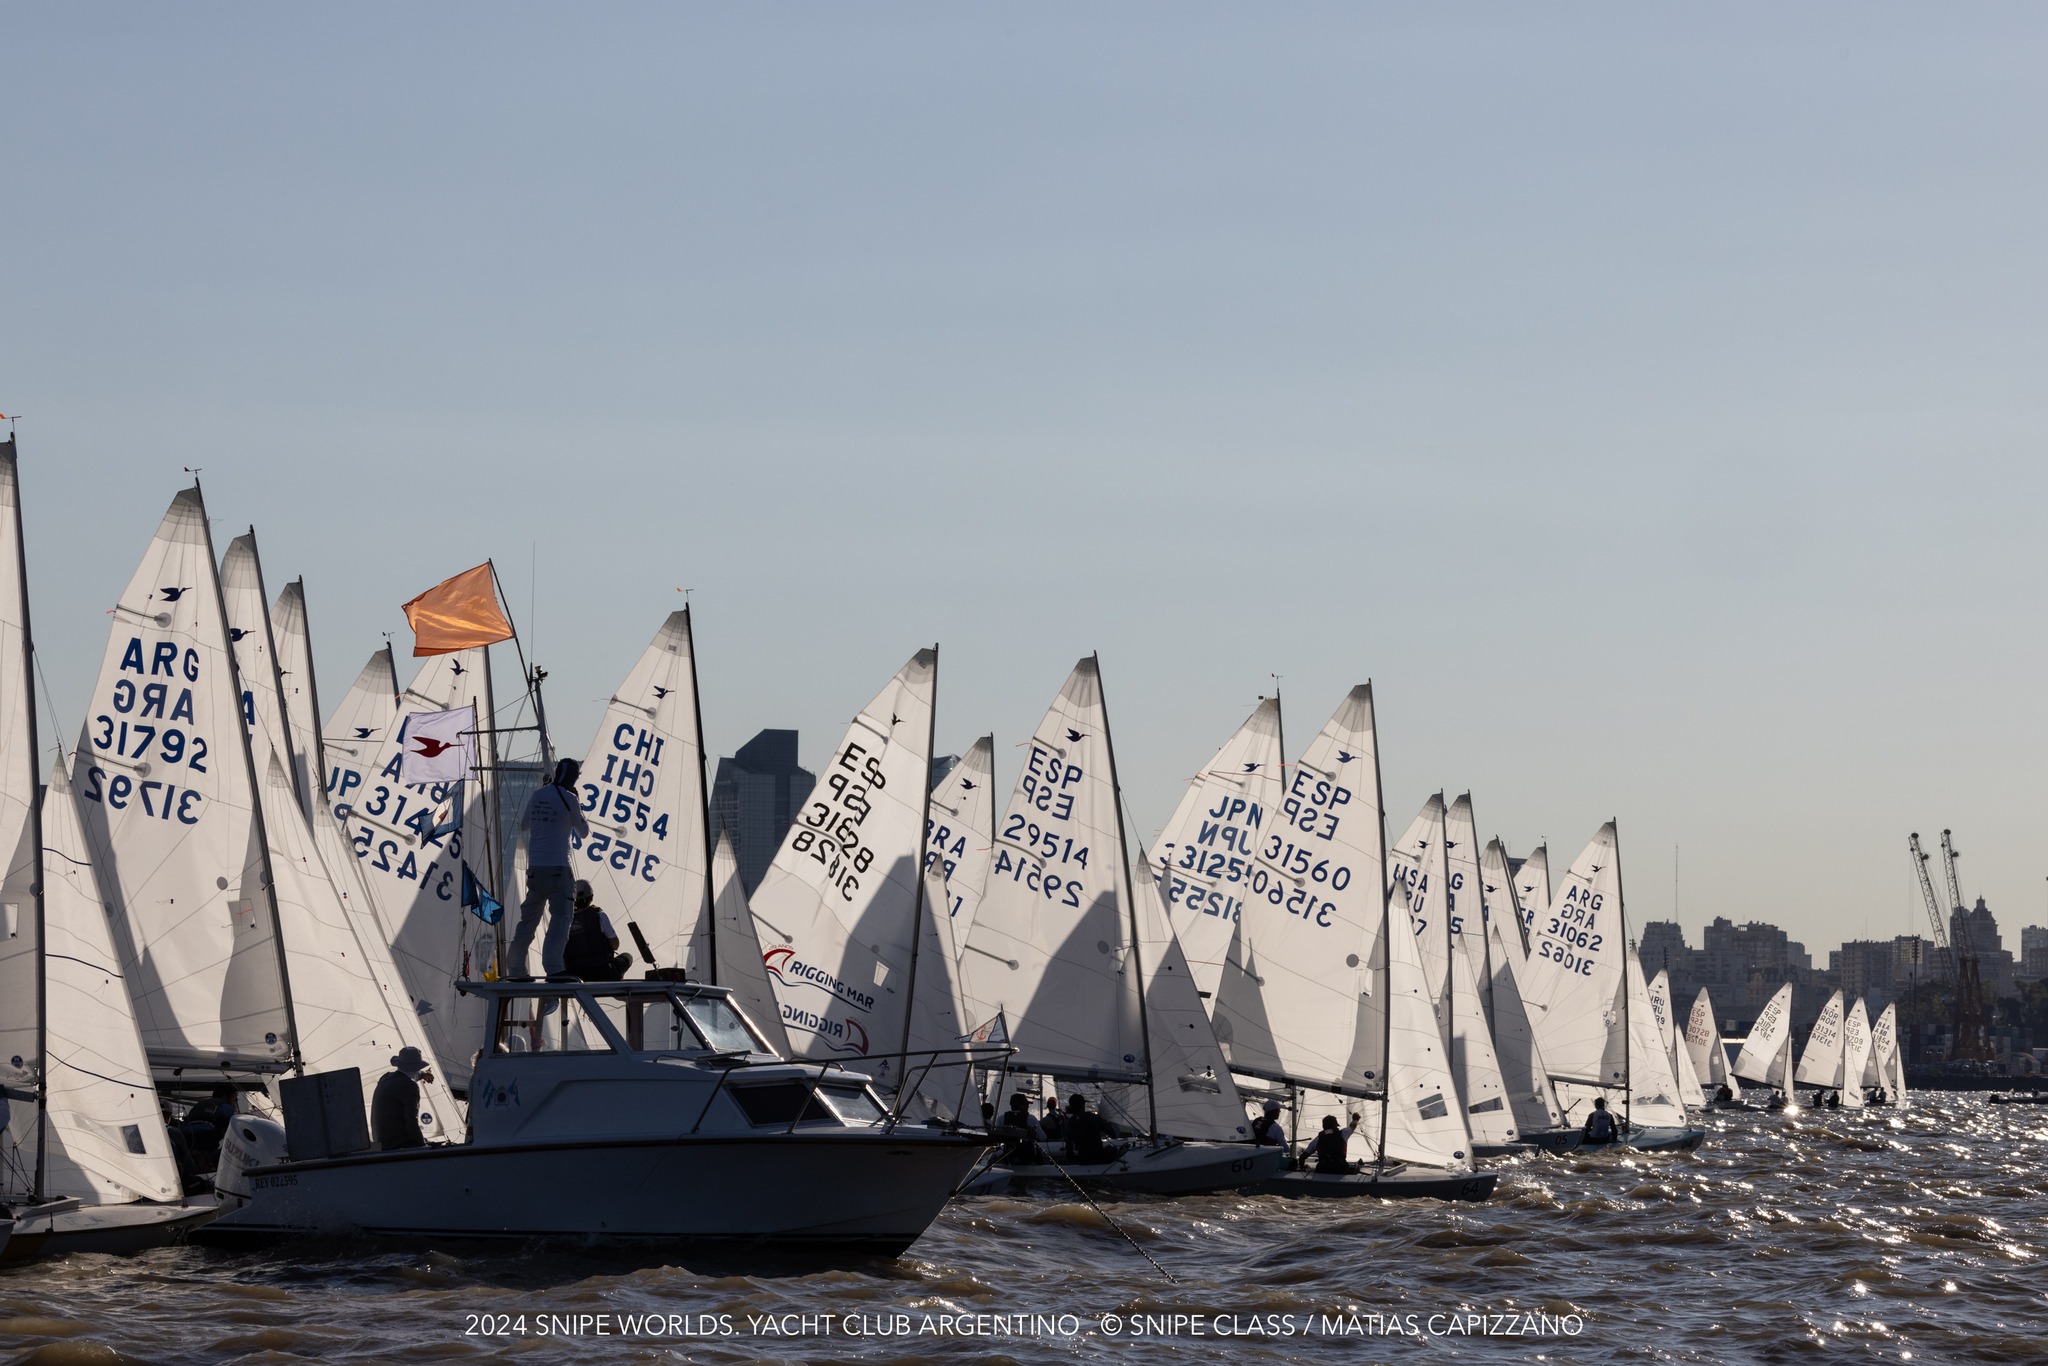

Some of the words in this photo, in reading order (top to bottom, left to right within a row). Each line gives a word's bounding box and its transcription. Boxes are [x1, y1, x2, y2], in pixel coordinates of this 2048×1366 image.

[120, 637, 200, 682] ARG
[93, 715, 208, 774] 31792
[613, 723, 664, 766] CHI
[1028, 746, 1082, 789] ESP
[1291, 770, 1352, 810] ESP
[581, 784, 670, 841] 31554
[1209, 796, 1263, 830] JPN
[1003, 814, 1088, 870] 29514
[1264, 835, 1350, 890] 31560
[1566, 885, 1604, 911] ARG
[1547, 918, 1602, 952] 31062
[790, 960, 844, 994] RIGGING
[847, 986, 874, 1010] MAR
[1692, 1009, 1706, 1018] ESP
[1767, 1004, 1782, 1016] ESP
[1822, 1008, 1838, 1019] NOR
[1848, 1020, 1862, 1028] ESP
[1688, 1024, 1710, 1038] 30728
[1815, 1024, 1836, 1038] 31314
[1231, 1158, 1254, 1172] 60
[256, 1177, 270, 1189] REY
[1462, 1182, 1480, 1196] 64
